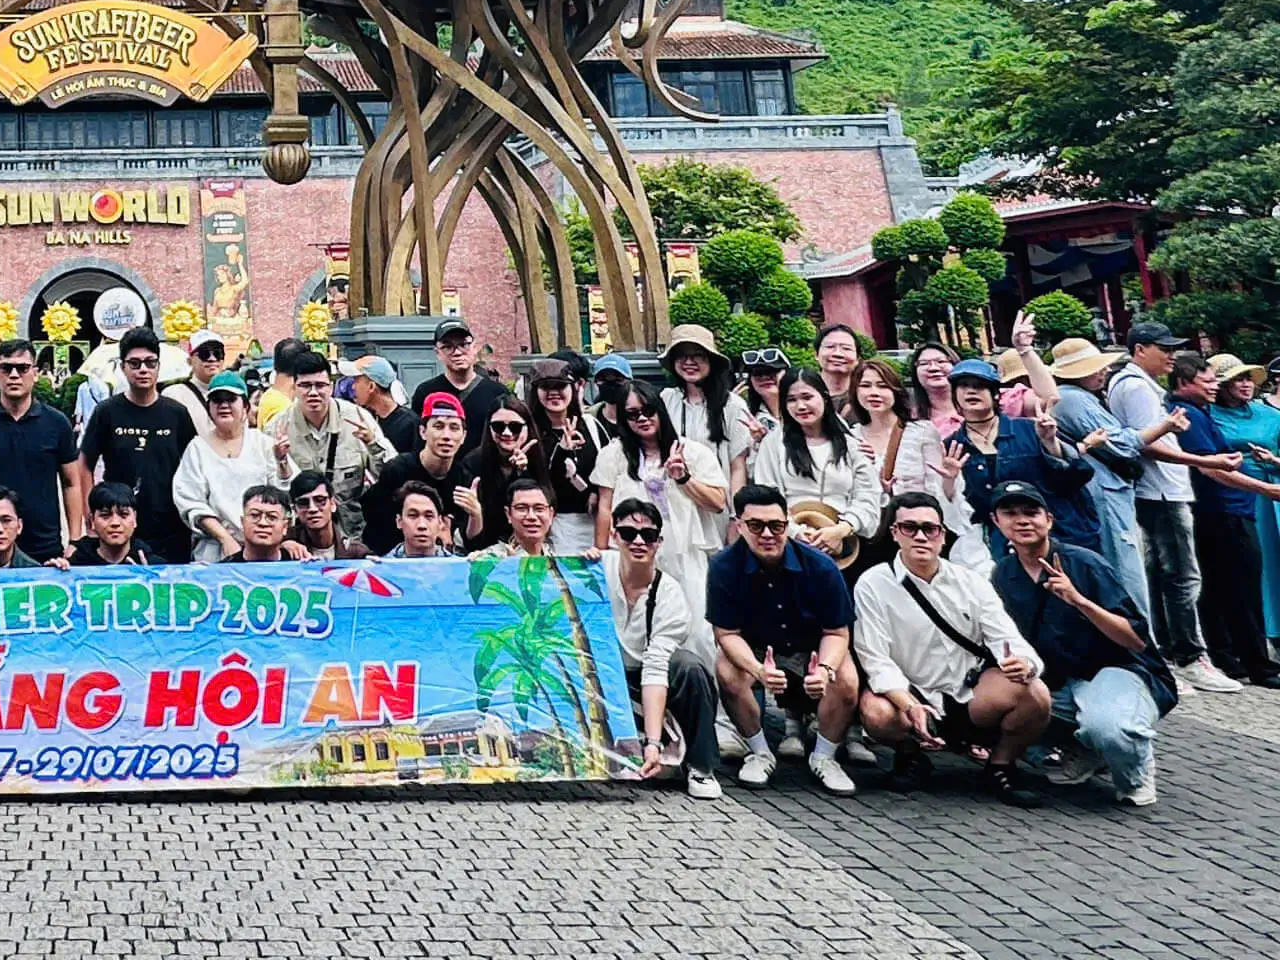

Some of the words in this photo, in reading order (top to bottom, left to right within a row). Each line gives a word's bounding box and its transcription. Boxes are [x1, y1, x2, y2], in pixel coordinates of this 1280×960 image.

[11, 17, 63, 62] SUN
[61, 8, 197, 66] KRAFTBEER
[45, 40, 172, 73] FESTIVAL
[148, 83, 167, 98] BIA
[60, 185, 190, 226] WORLD
[46, 231, 65, 245] BA
[70, 231, 91, 245] NA
[94, 230, 132, 245] HILLS
[78, 581, 210, 631] TRIP
[219, 583, 331, 636] 2025
[143, 651, 287, 744] HỘI
[303, 663, 417, 722] AN
